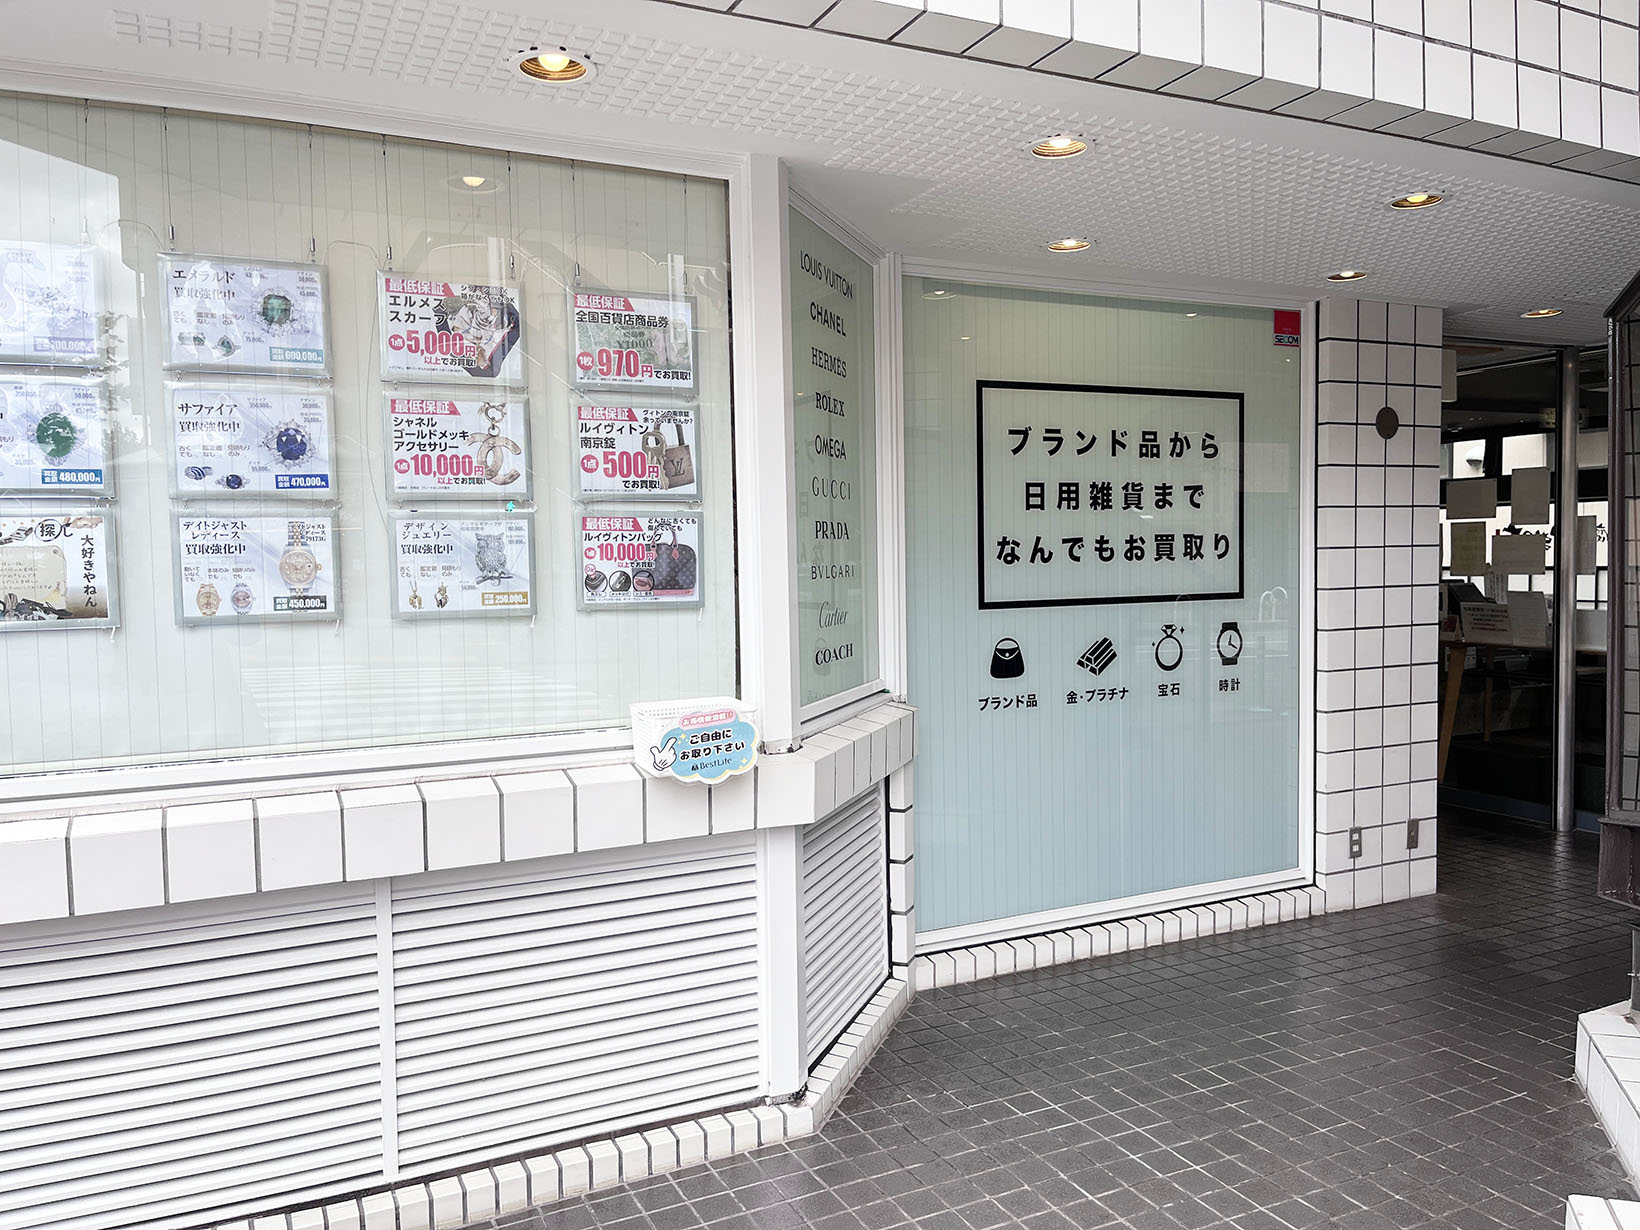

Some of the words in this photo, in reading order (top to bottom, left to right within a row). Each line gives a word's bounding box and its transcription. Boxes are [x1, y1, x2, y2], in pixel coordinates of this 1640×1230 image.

[173, 270, 235, 284] エメラルド
[801, 250, 822, 281] LOUIS
[824, 264, 853, 300] VUITTON
[174, 286, 235, 300] 買取強化中
[389, 281, 445, 294] 最低保証
[389, 295, 446, 310] エルメス
[577, 295, 625, 310] 最低保証
[389, 311, 447, 325] スカーフ
[576, 310, 669, 328] 全国百貨店商品券
[810, 301, 847, 337] CHANEL
[406, 329, 477, 358] 5,000円
[1275, 335, 1299, 344] SECOM
[424, 356, 477, 367] 以上でお買取!
[597, 348, 653, 378] 970円
[654, 371, 691, 380] でお買取!
[178, 403, 238, 416] サファイア
[395, 400, 450, 414] 最低保証
[815, 391, 845, 417] ROLEX
[580, 407, 629, 420] 最低保証
[179, 421, 240, 433] 買取強化中
[393, 417, 437, 428] シャネル
[580, 422, 649, 435] ルイヴィトン
[394, 429, 469, 441] ゴールドメッキ
[394, 441, 459, 452] アクセサリー
[580, 437, 616, 449] 南京錠
[814, 434, 847, 460] OMEGA
[1007, 426, 1220, 459] ブランド品から
[411, 453, 484, 478] 10,000円
[583, 459, 597, 469] 1点
[603, 451, 659, 479] 500円
[59, 472, 101, 483] 480,000円
[291, 477, 326, 487] 470,000円
[437, 477, 486, 485] 以上でお買取!
[622, 480, 660, 489] でお買取!
[812, 476, 851, 500] GUCCI
[1024, 481, 1205, 511] 日用雑貨まで
[183, 520, 247, 531] デイトジャスト
[403, 522, 448, 530] デザイン
[586, 518, 634, 530] 最低保証
[815, 520, 849, 540] PRADA
[191, 531, 240, 540] レディース
[402, 531, 451, 540] ジュエリー
[584, 533, 662, 542] ルイヴィトンバッグ
[185, 544, 246, 555] 買取強化中
[401, 544, 453, 554] 買取強化中
[597, 543, 654, 562] 10,000円
[996, 532, 1230, 565] なんでもお買取り
[81, 535, 98, 607] 大好きやねん
[811, 564, 854, 580] BVLGARI
[289, 599, 325, 609] 450,000円
[819, 601, 848, 629] Cartier
[815, 643, 853, 666] COACH
[1158, 683, 1180, 697] 宝石
[1218, 678, 1241, 692] 時計
[978, 693, 1038, 712] ブランド品
[1066, 687, 1129, 705] 金・プラチナ
[689, 729, 732, 745] ご自由に
[680, 741, 745, 760] お取り下さい
